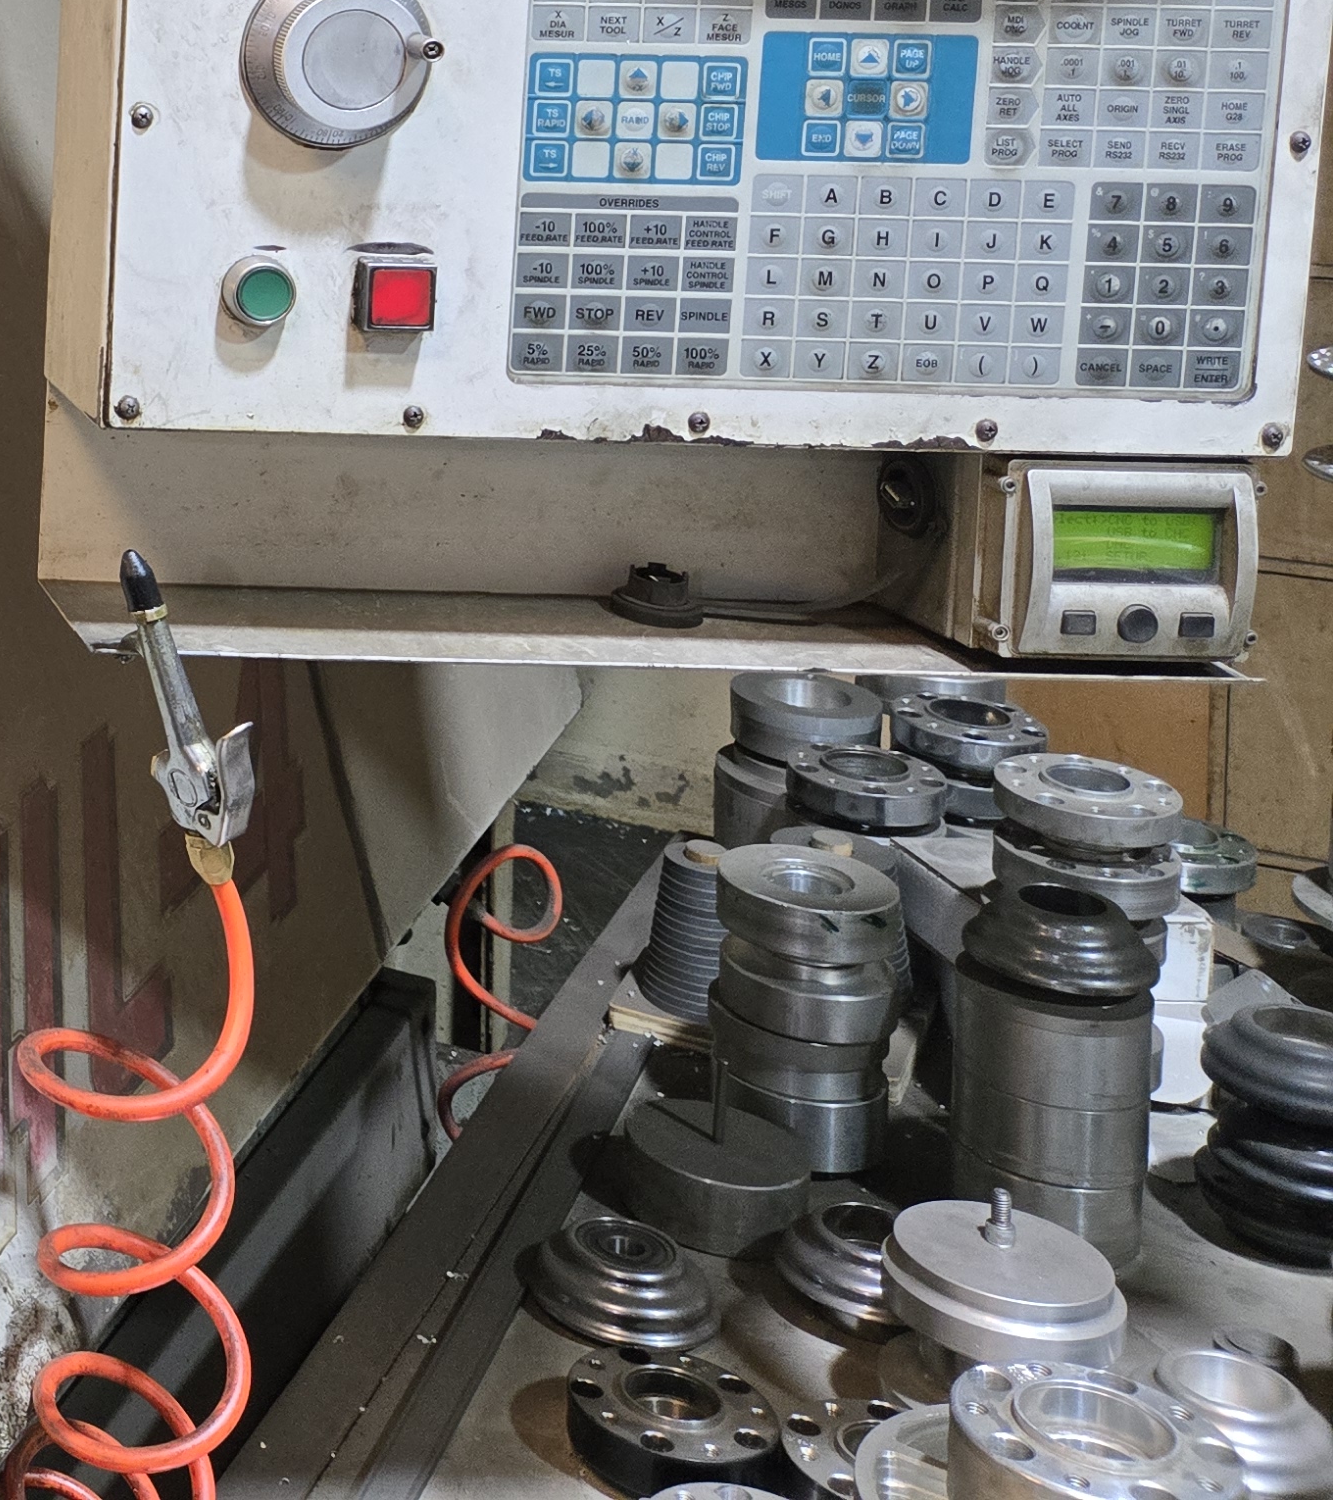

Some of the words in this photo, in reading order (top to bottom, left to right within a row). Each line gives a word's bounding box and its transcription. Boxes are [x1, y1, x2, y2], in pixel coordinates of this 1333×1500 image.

[600, 16, 627, 25] NEXT
[1111, 18, 1149, 27] SPINDLE
[1166, 18, 1202, 27] TURRET
[1223, 20, 1260, 28] TURRET
[600, 26, 626, 34] TOOL
[711, 23, 738, 32] FACE
[539, 30, 574, 38] MESUR
[706, 33, 742, 41] MESUR
[1119, 28, 1139, 37] JOG
[1173, 28, 1193, 37] FWD
[1232, 30, 1251, 38] REV
[813, 52, 841, 62] HOME
[900, 50, 924, 58] PAGE
[993, 56, 1030, 65] HANDLE
[711, 72, 732, 81] CHIP
[847, 94, 886, 103] CURSOR
[1057, 94, 1081, 102] AUTO
[1060, 103, 1077, 112] ALL
[1107, 104, 1139, 113] ORIGIN
[1221, 102, 1248, 111] HOME
[708, 112, 729, 121] CHIP
[1055, 113, 1080, 122] AXES
[537, 118, 566, 127] RAPID
[705, 122, 731, 131] STOP
[1048, 139, 1083, 148] SELECT
[1107, 140, 1132, 149] SEND
[1216, 143, 1246, 152] ERASE
[705, 153, 727, 162] CHIP
[1051, 149, 1077, 158] PROG
[1105, 150, 1133, 159] RS232
[1217, 152, 1243, 162] PROG
[825, 189, 838, 204] A
[880, 190, 892, 204] B
[599, 198, 660, 208] OVERRIDES
[535, 221, 555, 232] -10
[582, 222, 617, 234] 100%
[693, 220, 729, 228] HANDLE
[644, 224, 667, 235] +10
[689, 230, 732, 238] CONTROL
[822, 230, 835, 245] G
[1040, 235, 1052, 249] K
[686, 239, 708, 247] FEED
[711, 240, 734, 248] RATE
[818, 271, 833, 287] M
[524, 307, 556, 319] FWD
[575, 309, 614, 320] STOP
[636, 309, 664, 321] REV
[681, 311, 728, 321] SPINDLE
[527, 344, 548, 356] 5%
[578, 345, 606, 357] 25%
[632, 346, 662, 358] 50%
[684, 348, 720, 360] 100%
[916, 358, 938, 368] EOB
[1196, 356, 1229, 365] WRITE
[1080, 363, 1121, 372] CANCEL
[1139, 364, 1172, 373] SPACE
[1194, 374, 1228, 383] ENTER
